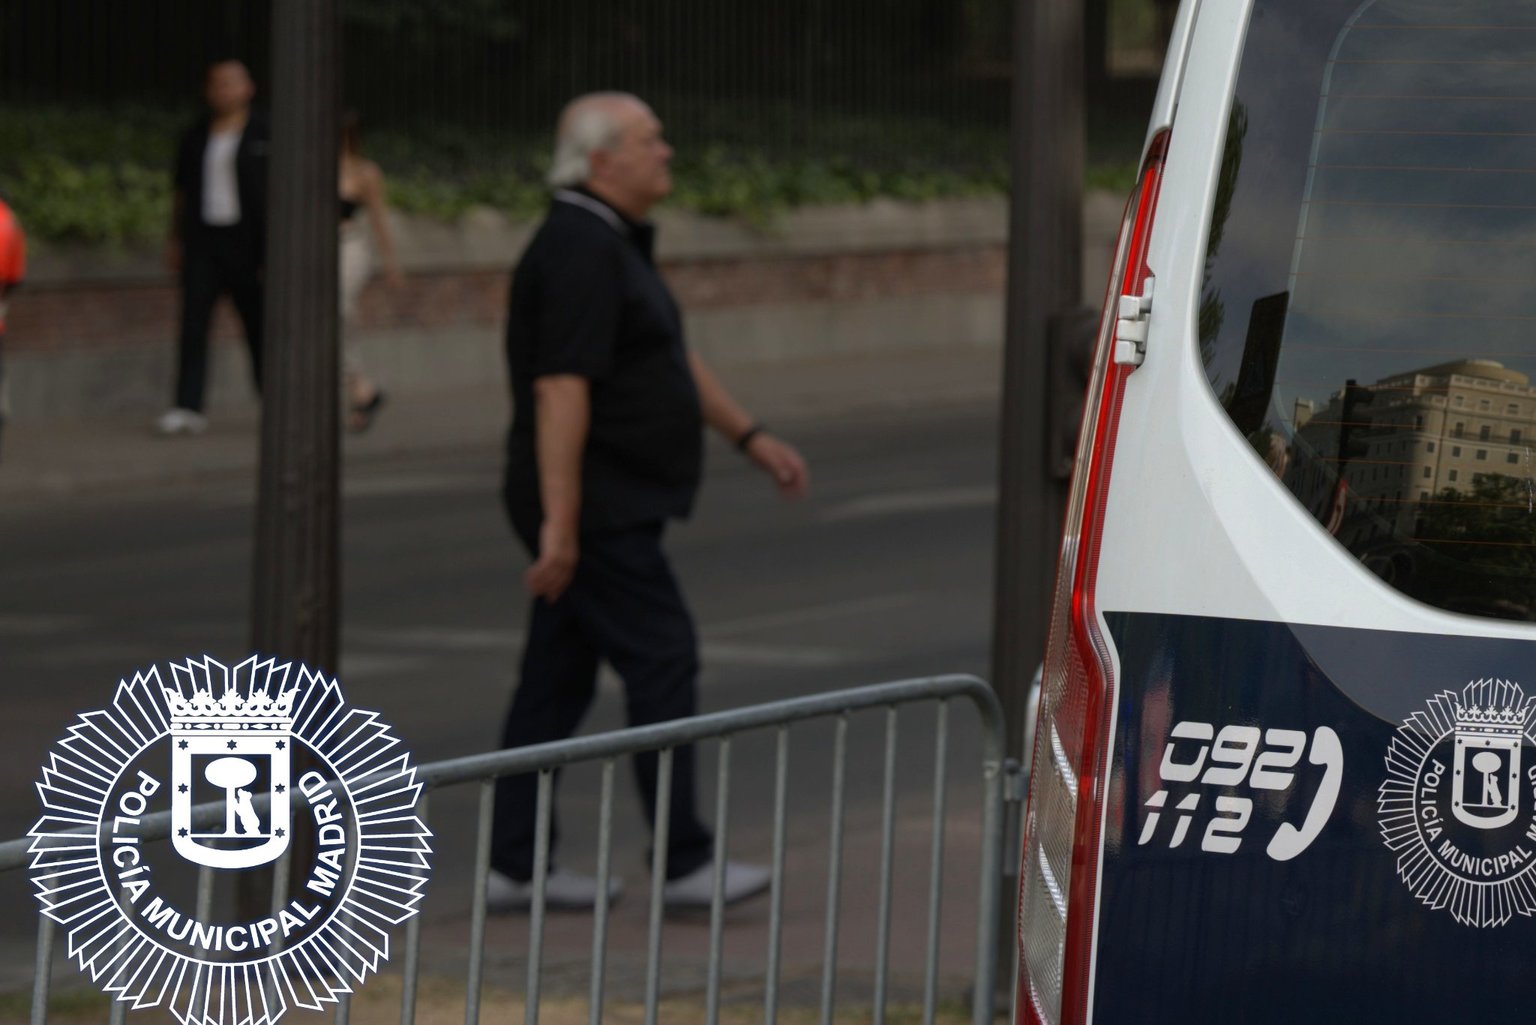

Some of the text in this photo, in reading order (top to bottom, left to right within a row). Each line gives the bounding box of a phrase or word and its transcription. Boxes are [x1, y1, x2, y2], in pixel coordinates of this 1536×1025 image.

[1159, 721, 1307, 791] 092
[1137, 789, 1253, 854] 112
[1420, 758, 1446, 843] POLICÍA
[1437, 839, 1533, 877] MUNICIPAL
